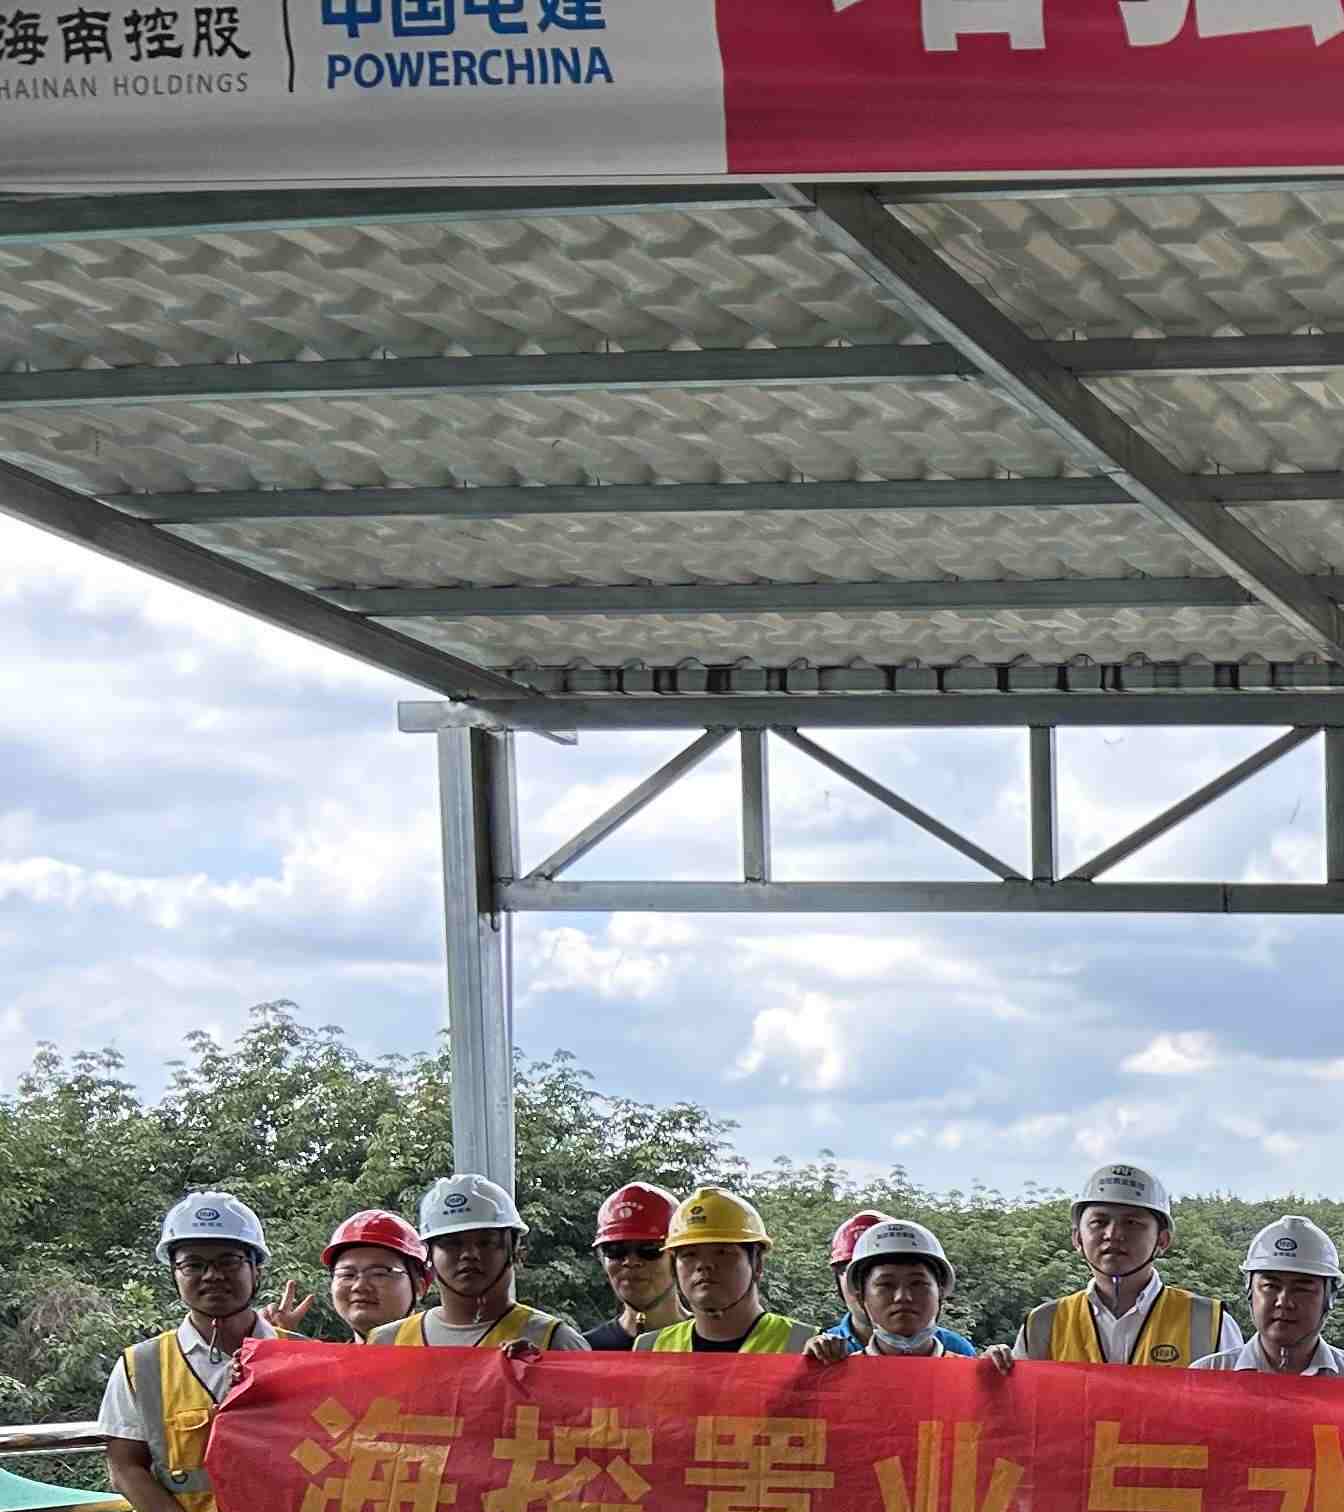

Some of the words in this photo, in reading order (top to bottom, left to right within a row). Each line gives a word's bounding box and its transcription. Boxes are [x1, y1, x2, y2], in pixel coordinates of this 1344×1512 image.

[0, 8, 251, 64] 海南控股
[0, 76, 96, 99] HAINAN
[113, 73, 248, 95] HOLDINGS
[327, 47, 614, 89] POWERCHINA
